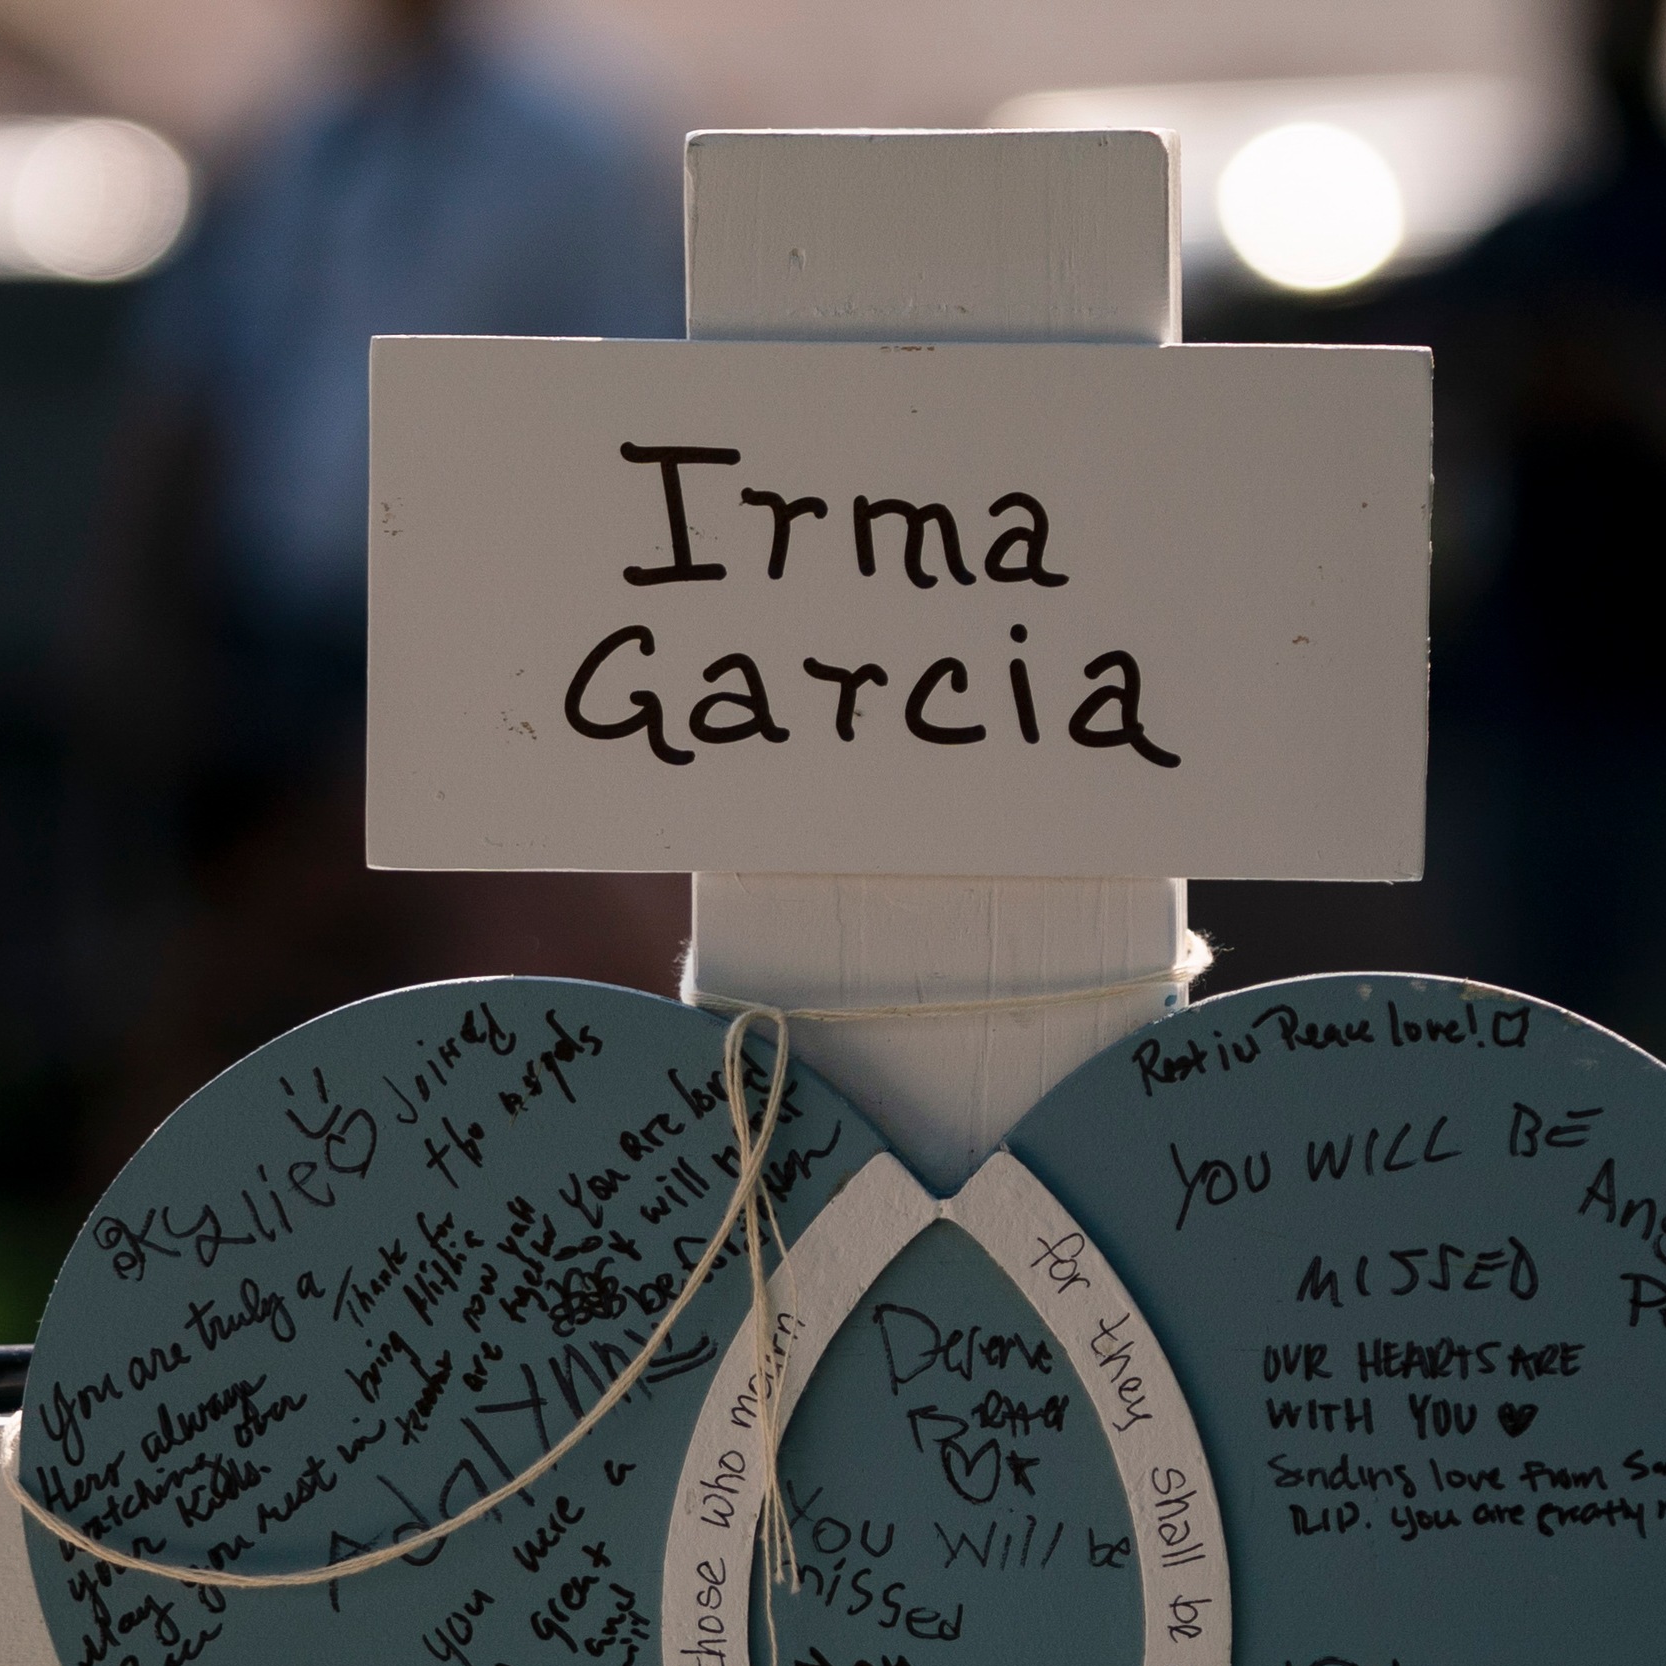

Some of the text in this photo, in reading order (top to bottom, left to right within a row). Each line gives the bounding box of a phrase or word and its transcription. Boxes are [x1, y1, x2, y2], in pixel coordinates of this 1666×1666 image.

[619, 440, 1070, 589] Irma
[564, 622, 1182, 769] Garcia
[1132, 1038, 1207, 1097] Rest
[558, 1172, 631, 1230] You
[619, 1112, 686, 1162] are
[667, 1048, 774, 1121] lovd
[1169, 1101, 1605, 1231] YOU WILL BE
[640, 1156, 711, 1225] will
[333, 1237, 408, 1328] Thank
[1295, 1235, 1540, 1308] MISSED
[38, 1270, 326, 1467] You are truly a
[462, 1341, 505, 1393] are
[1263, 1336, 1587, 1384] OUR HEARTS ARE
[233, 1393, 308, 1449] over
[1265, 1393, 1479, 1441] WITH YOU
[36, 1450, 126, 1513] Hero
[257, 1455, 338, 1535] rest
[336, 1416, 387, 1464] in
[698, 1449, 747, 1529] who
[1089, 1312, 1154, 1433] they
[1167, 1594, 1213, 1644] be
[1429, 1456, 1506, 1493] love
[511, 1495, 587, 1571] were
[602, 1458, 637, 1487] a
[1088, 1528, 1131, 1569] be
[1390, 1504, 1463, 1542] you
[1471, 1501, 1526, 1527] are
[529, 1540, 614, 1653] great
